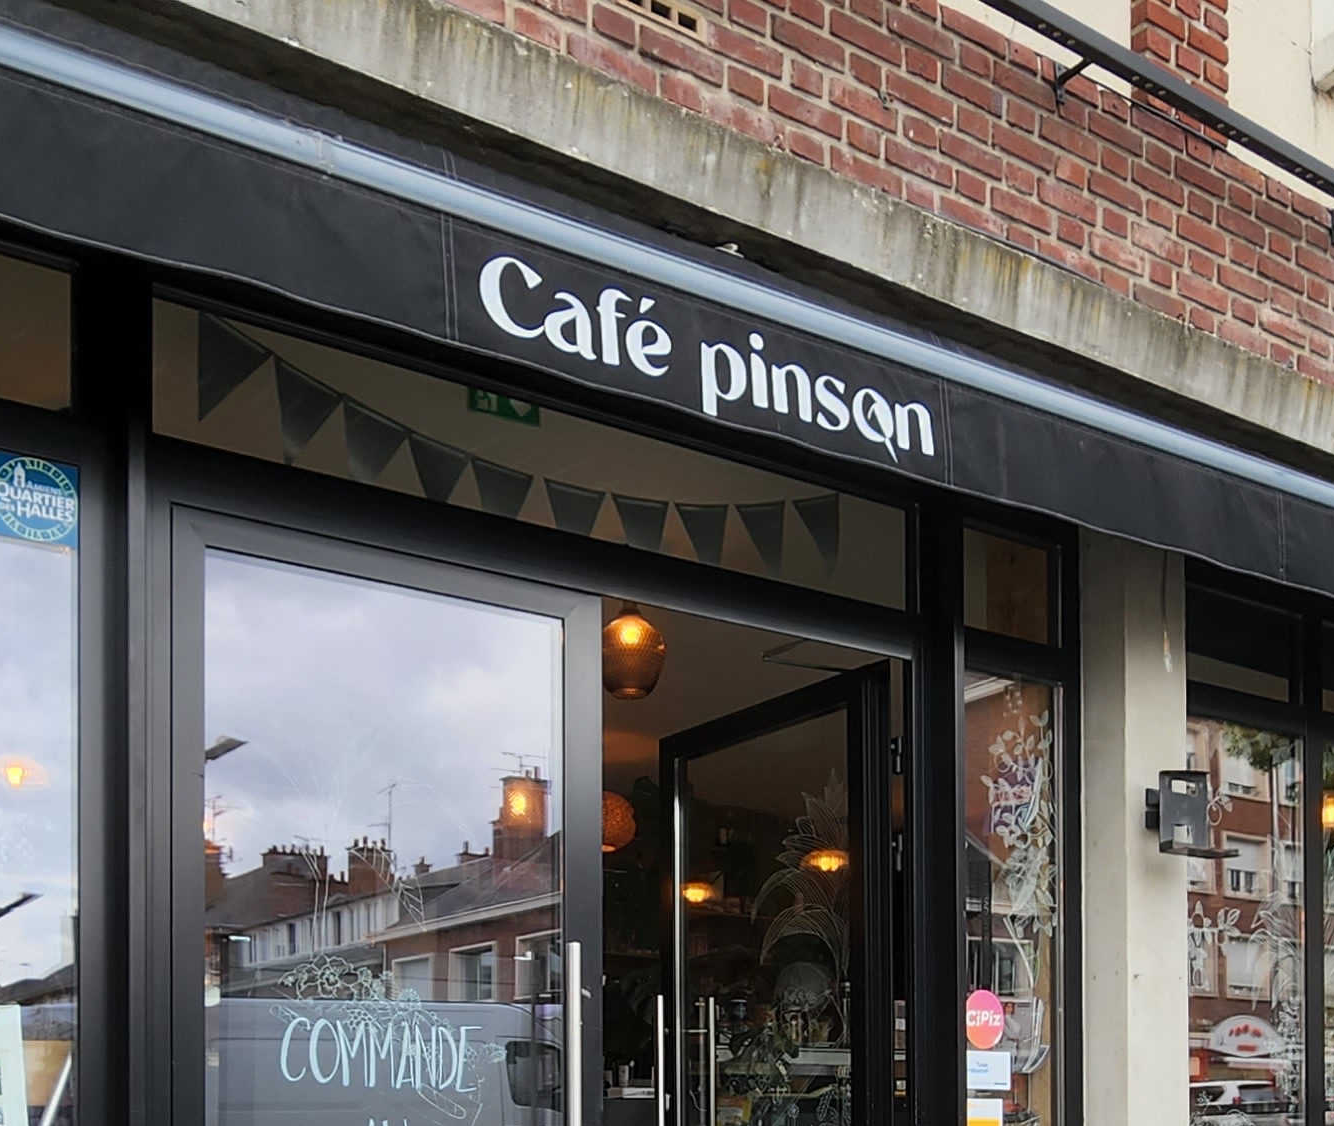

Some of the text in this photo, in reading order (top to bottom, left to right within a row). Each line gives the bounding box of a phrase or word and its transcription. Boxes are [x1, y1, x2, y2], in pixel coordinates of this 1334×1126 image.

[479, 256, 935, 463] Café pinson
[17, 501, 74, 523] HALLES
[280, 1016, 483, 1092] COMMANDE
